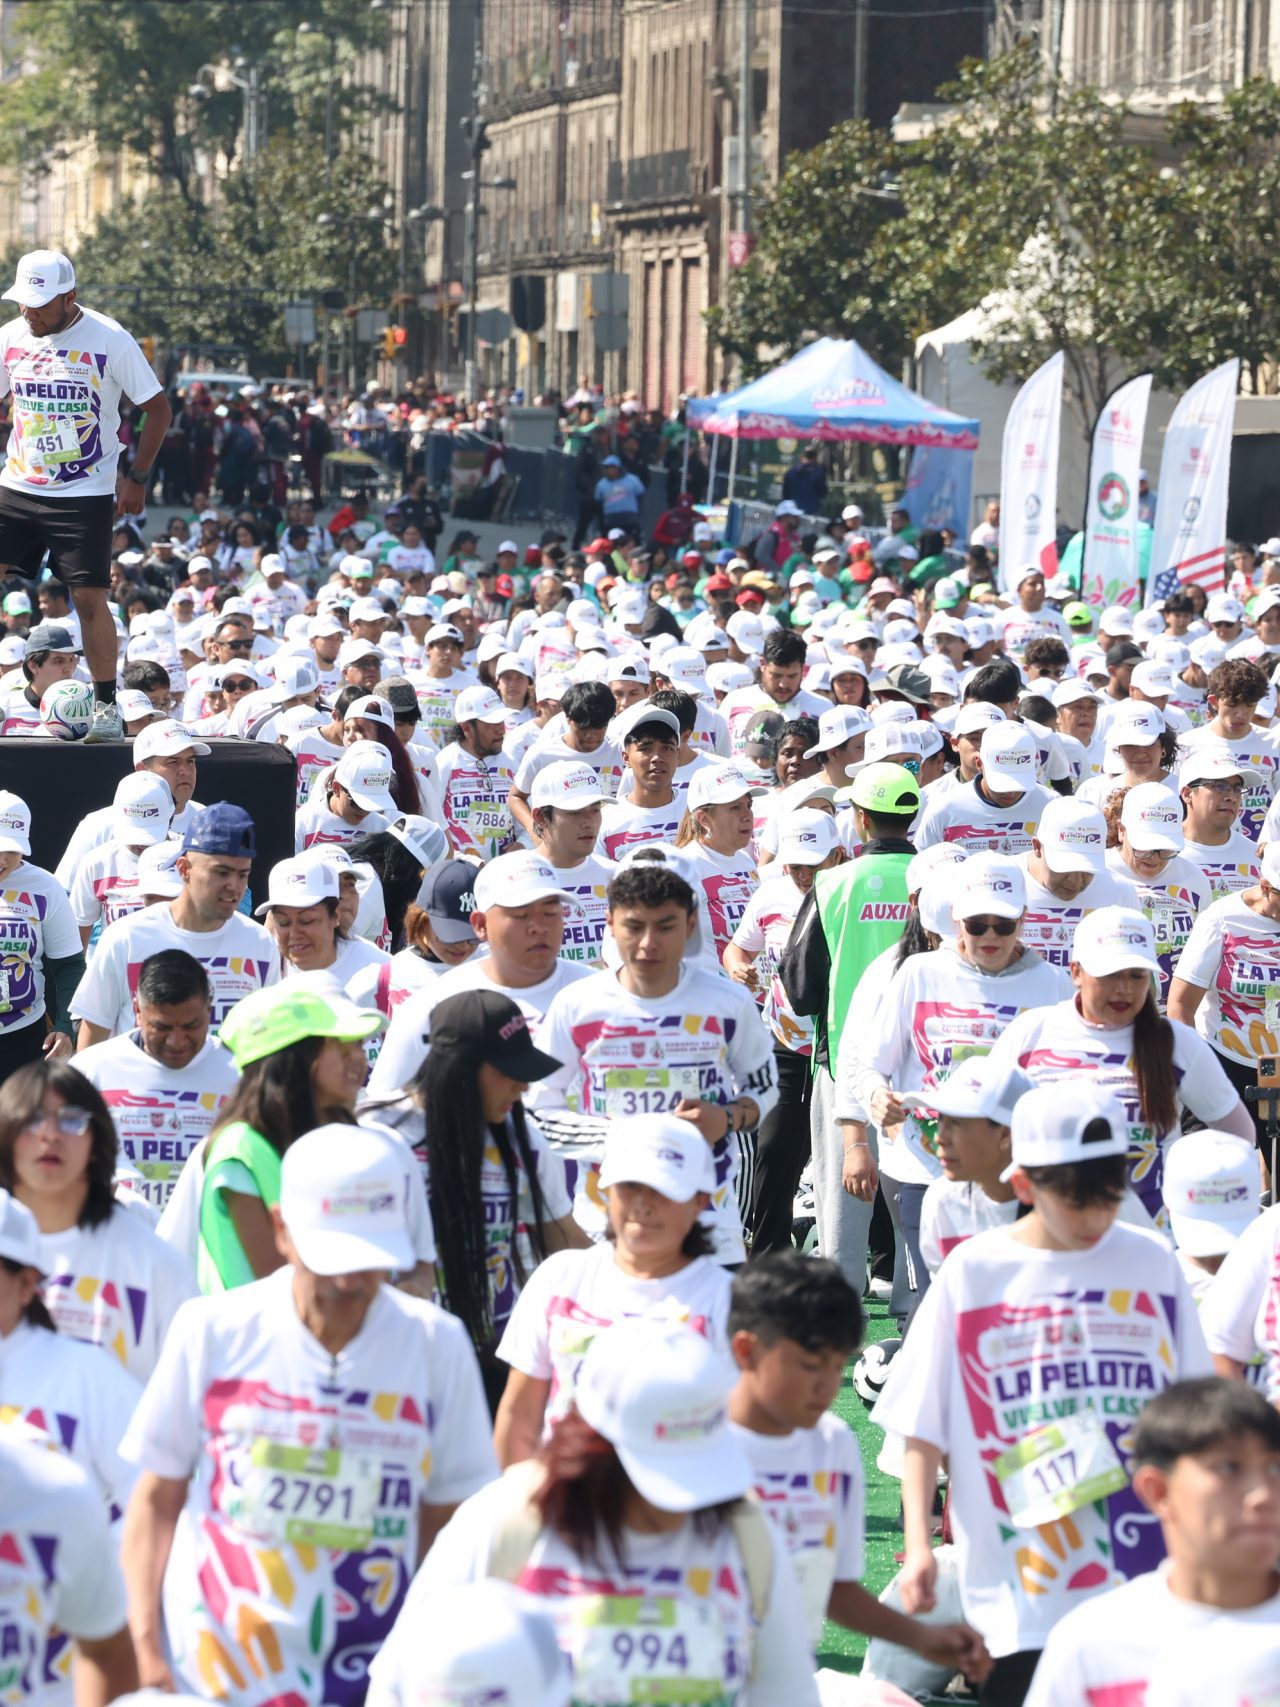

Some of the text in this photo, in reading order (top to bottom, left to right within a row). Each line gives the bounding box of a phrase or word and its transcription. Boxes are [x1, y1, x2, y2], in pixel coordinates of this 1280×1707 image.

[26, 383, 89, 400] PELOTA
[48, 402, 55, 412] A
[58, 403, 88, 412] CASA
[36, 435, 64, 453] 451
[426, 706, 452, 719] 6496
[453, 796, 471, 808] LA
[476, 811, 506, 828] 7886
[860, 903, 911, 921] AUXI
[562, 924, 607, 944] PELO
[588, 945, 597, 959] A
[1237, 962, 1265, 981] LA
[1236, 982, 1265, 995] VUE
[623, 1090, 683, 1115] 3124
[142, 1140, 194, 1161] PEL
[995, 1360, 1157, 1403] LA PELOTA
[1032, 1451, 1079, 1494] 117
[268, 1477, 354, 1519] 2791
[611, 1633, 691, 1669] 994
